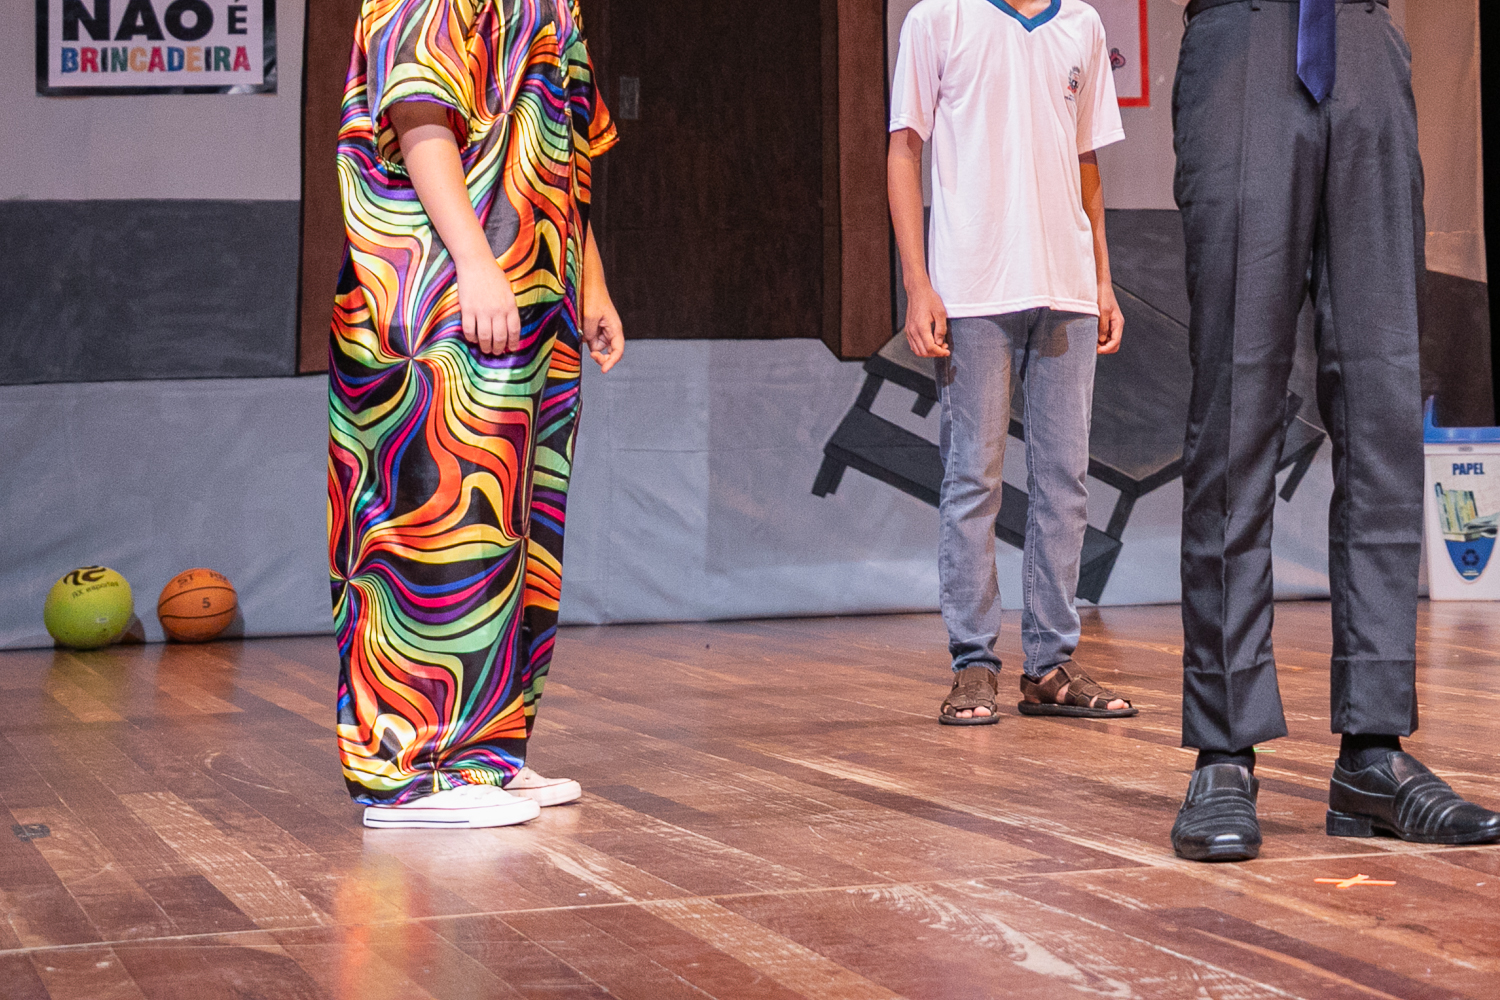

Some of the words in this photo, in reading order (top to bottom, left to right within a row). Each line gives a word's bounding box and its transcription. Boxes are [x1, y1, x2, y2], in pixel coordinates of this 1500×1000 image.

[61, 46, 251, 73] BRINCADEIRA
[1452, 462, 1485, 475] PAPEL
[203, 597, 212, 609] 5
